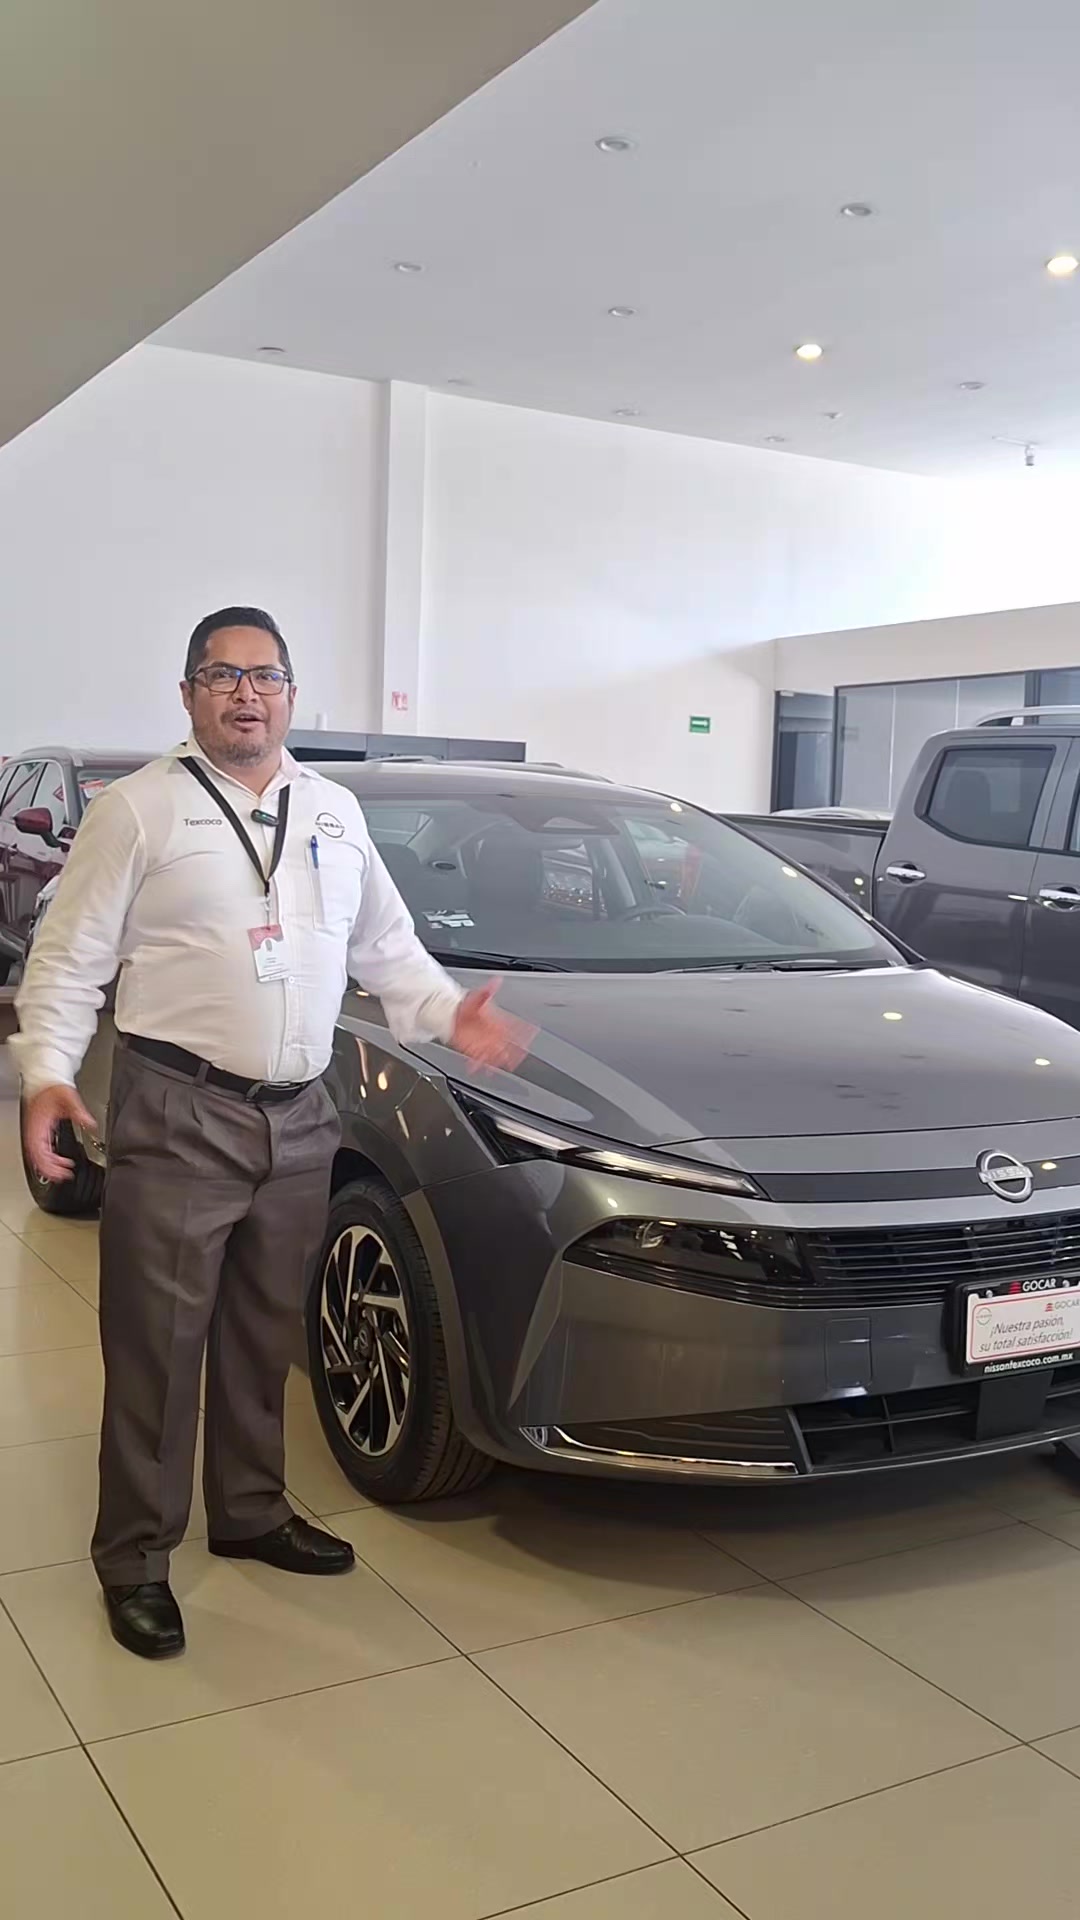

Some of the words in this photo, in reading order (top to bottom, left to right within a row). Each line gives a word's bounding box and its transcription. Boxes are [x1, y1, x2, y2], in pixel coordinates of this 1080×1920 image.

[183, 818, 222, 827] Texcoco
[1022, 1278, 1056, 1292] GOCAR
[979, 1343, 992, 1352] su
[993, 1336, 1016, 1350] total
[984, 1353, 1073, 1373] nissantexcoco.com.mx
